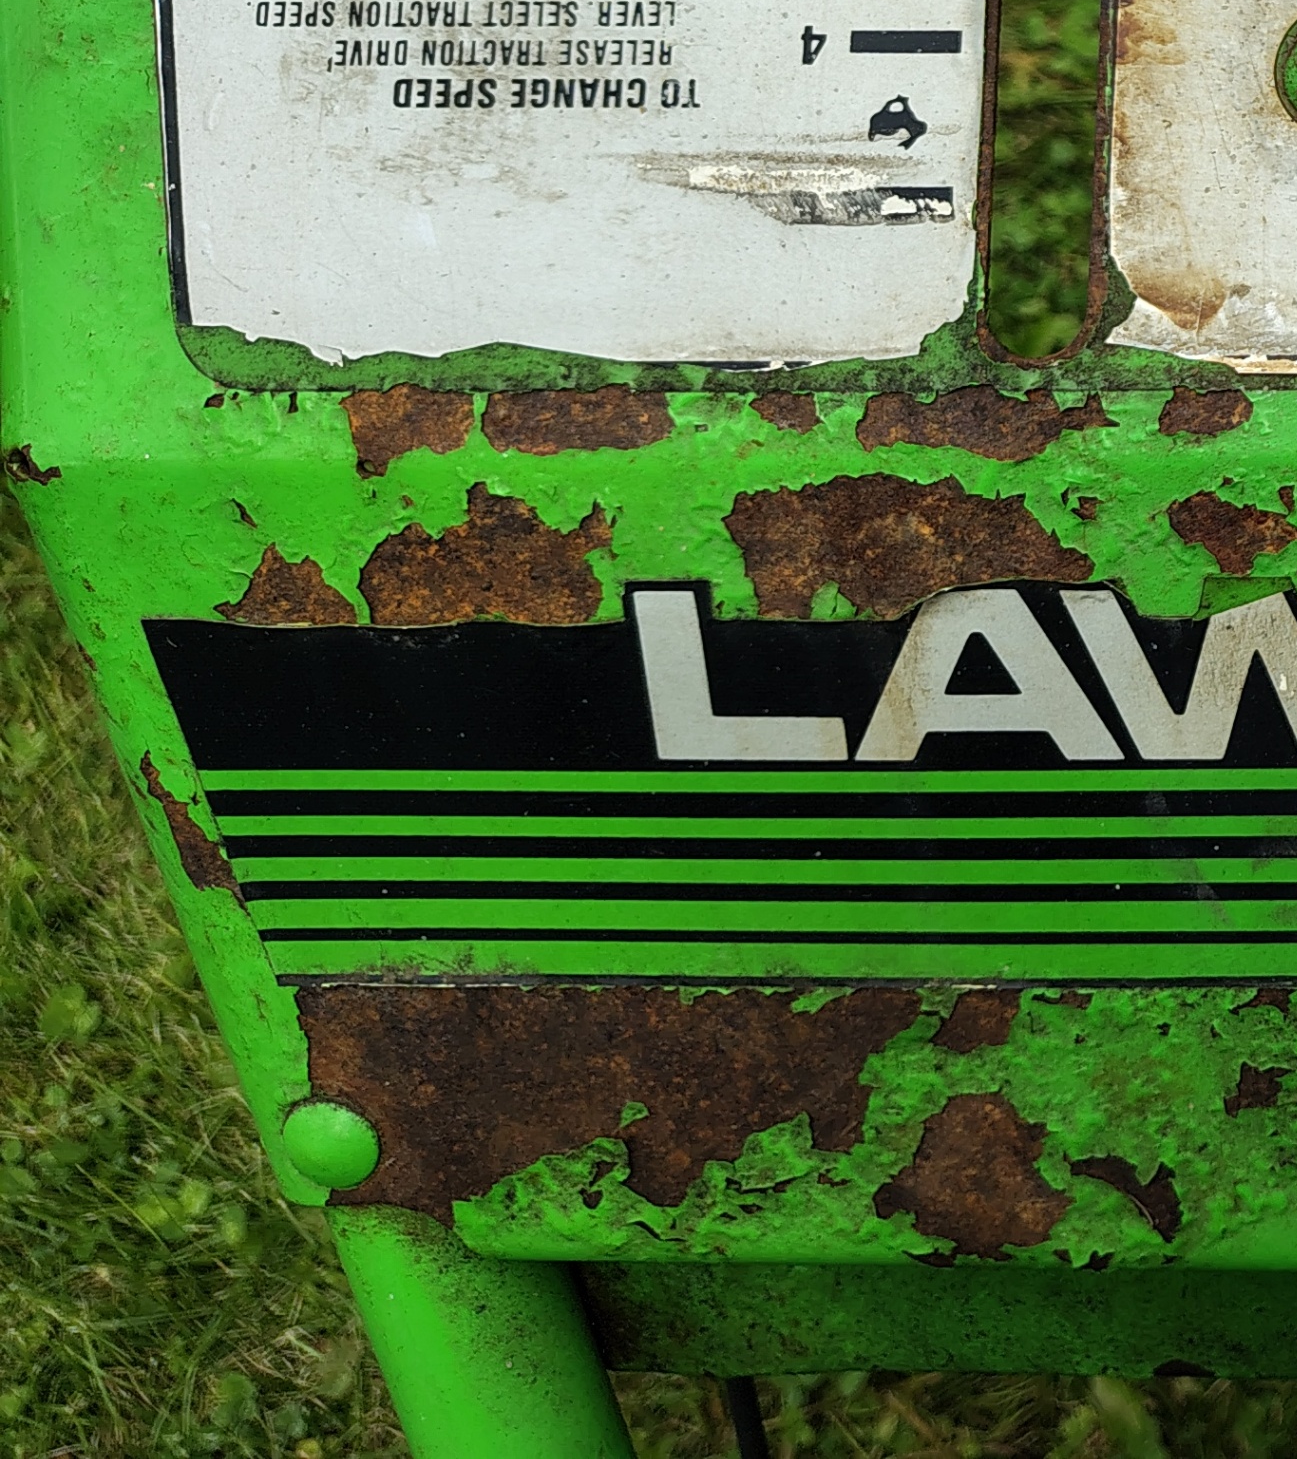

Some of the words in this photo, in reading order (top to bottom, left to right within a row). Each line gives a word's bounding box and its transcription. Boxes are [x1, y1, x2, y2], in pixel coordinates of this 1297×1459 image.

[348, 0, 473, 28] TRACTION
[481, 0, 579, 28] SELECT
[421, 39, 547, 67] TRACTION
[557, 39, 673, 66] RELEASE
[800, 25, 827, 66] 4
[393, 78, 497, 109] SPEED
[510, 77, 646, 109] CHANGE
[660, 78, 701, 109] TO
